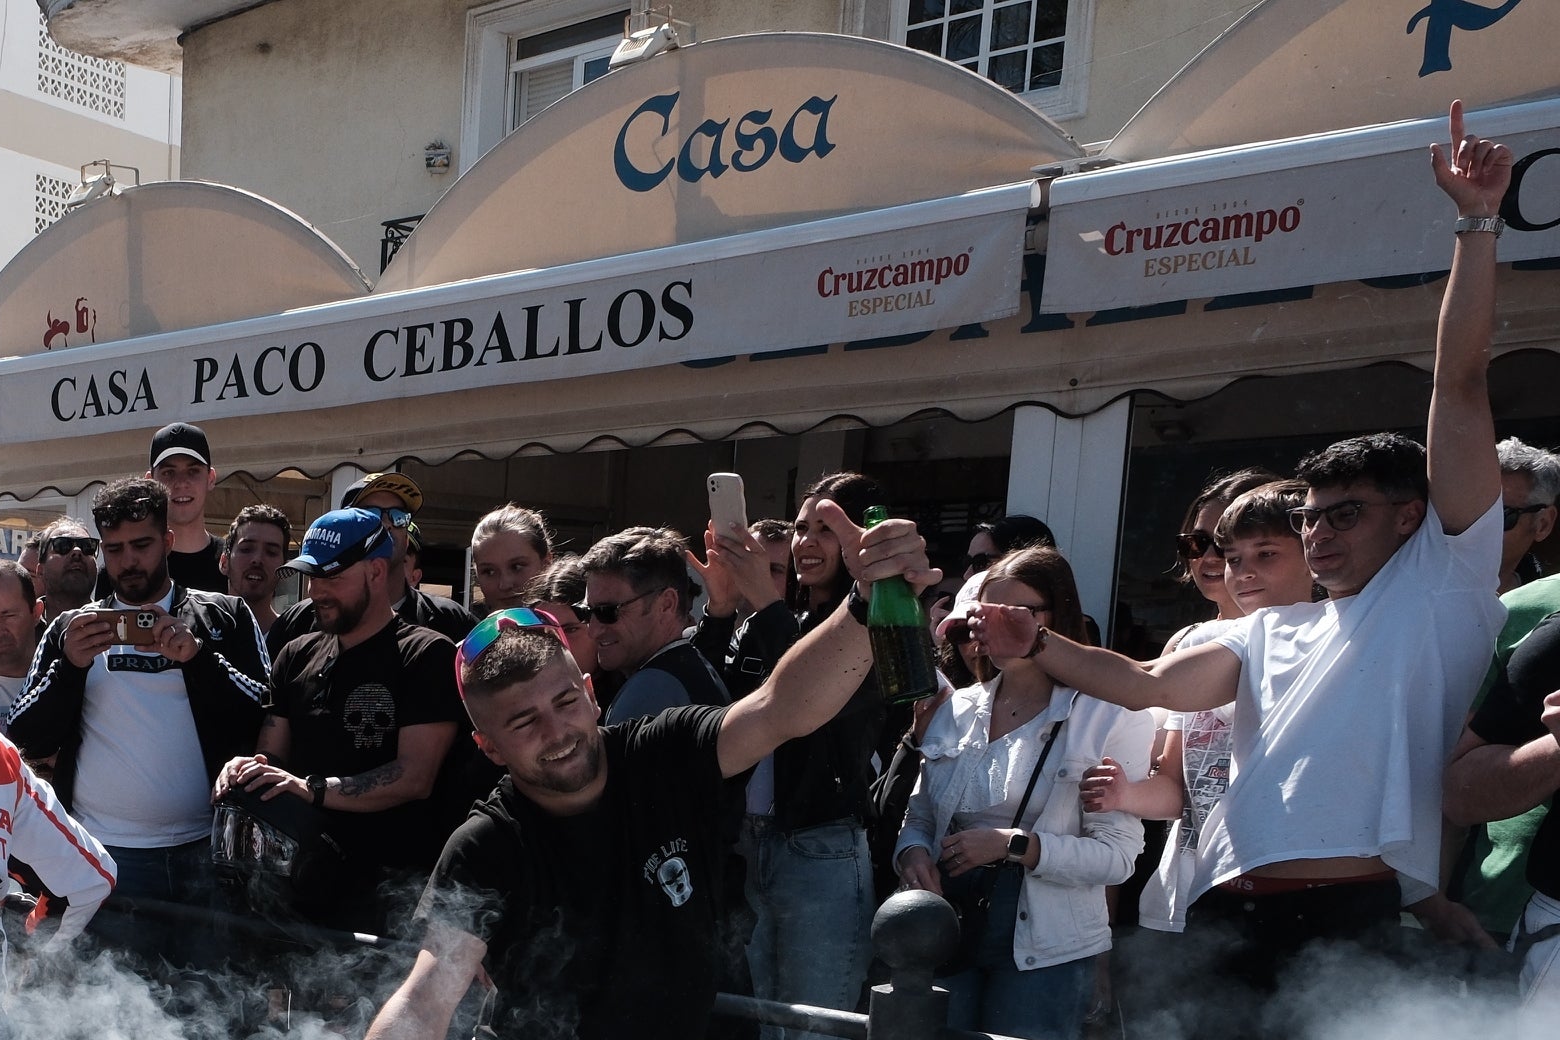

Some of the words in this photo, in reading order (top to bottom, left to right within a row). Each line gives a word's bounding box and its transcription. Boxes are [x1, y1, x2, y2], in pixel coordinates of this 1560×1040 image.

[613, 90, 838, 192] Casa
[1104, 205, 1301, 256] Cruzcampo
[817, 252, 970, 298] Cruzcampo
[1144, 246, 1256, 277] ESPECIAL
[847, 288, 935, 318] ESPECIAL
[51, 367, 159, 422] CASA
[191, 341, 325, 404] PACO
[363, 278, 694, 382] CEBALLOS
[112, 656, 175, 670] PRAD
[660, 837, 688, 857] LIFE
